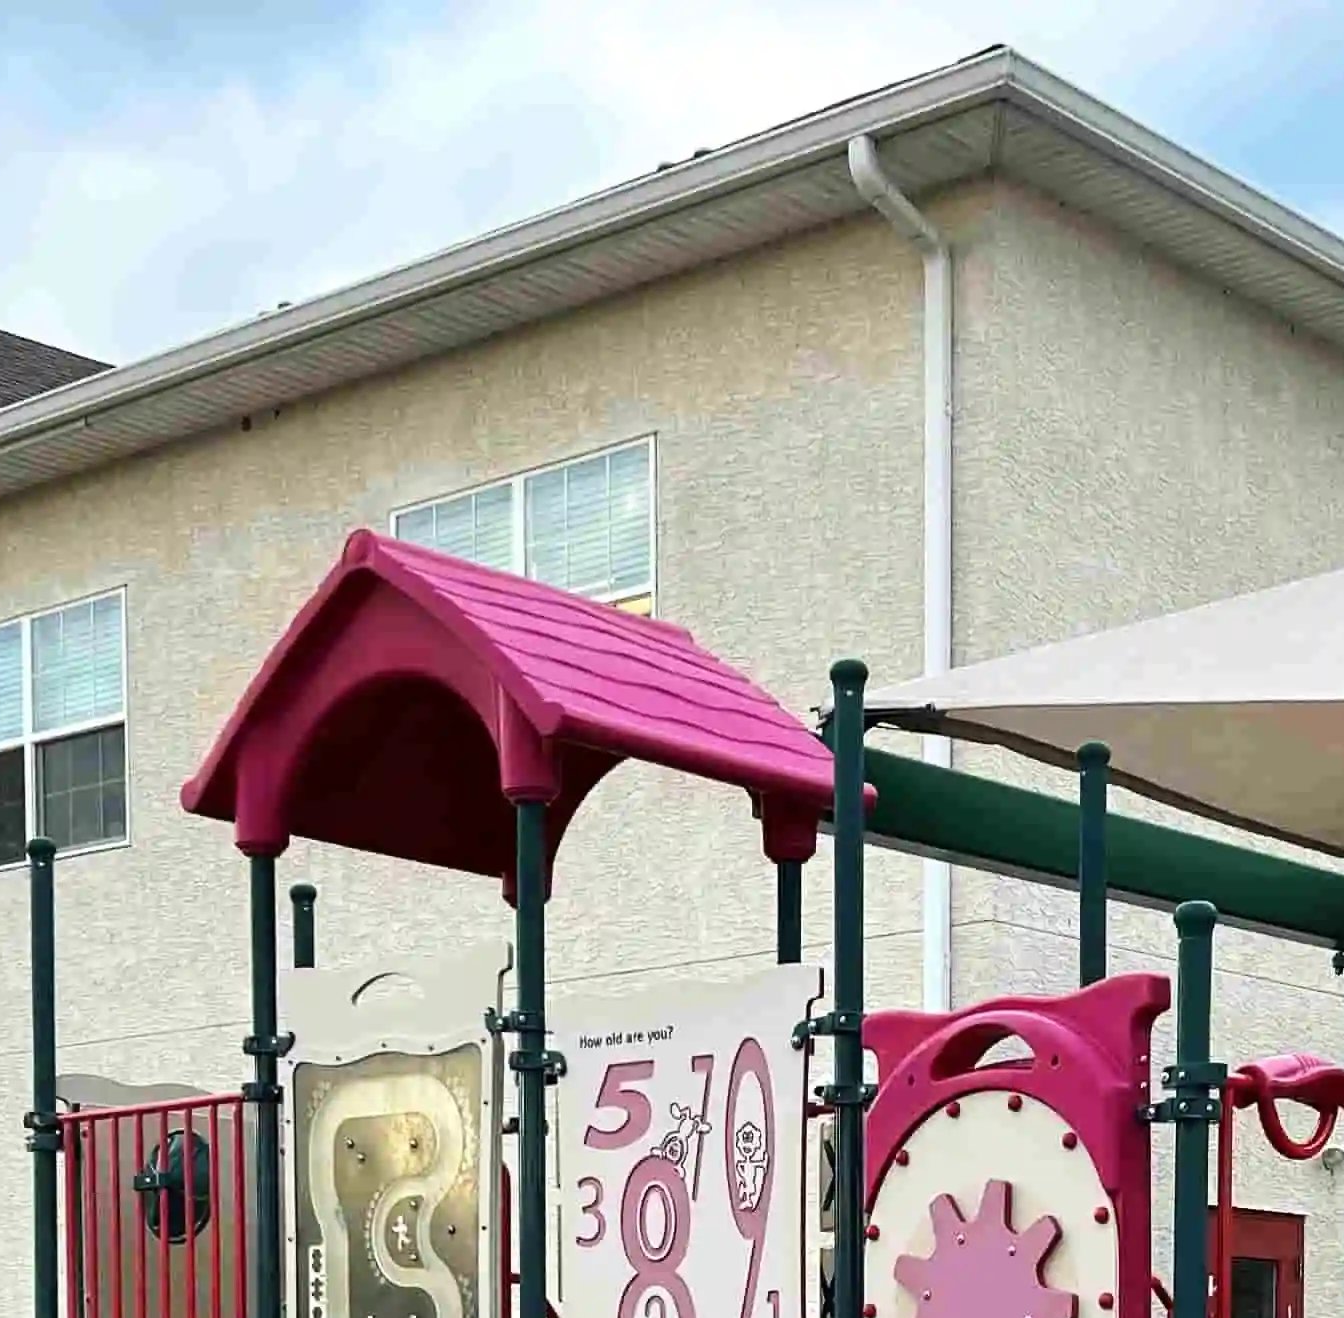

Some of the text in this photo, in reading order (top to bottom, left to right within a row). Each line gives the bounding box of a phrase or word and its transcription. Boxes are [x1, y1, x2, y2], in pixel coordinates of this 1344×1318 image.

[579, 1025, 674, 1049] How old are you?
[584, 1059, 654, 1149] 5
[691, 1054, 714, 1201] 7
[575, 1176, 606, 1247] 3
